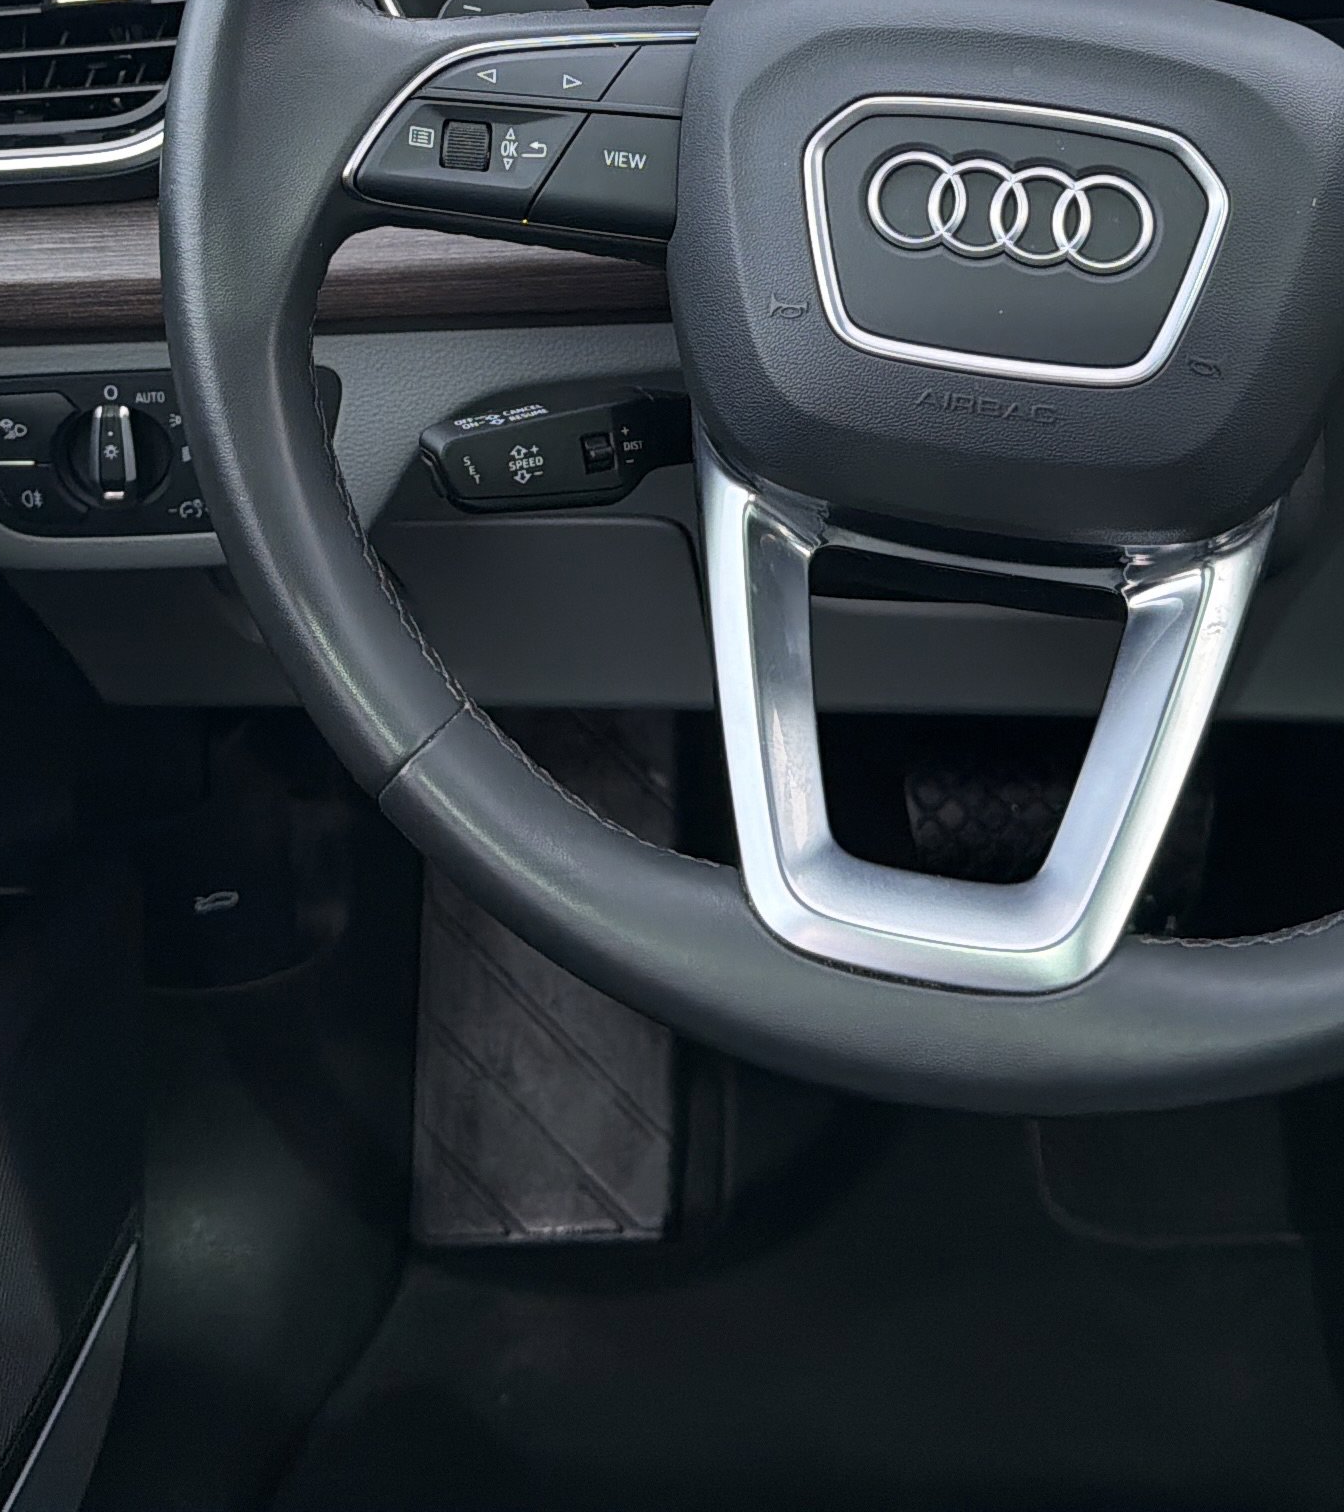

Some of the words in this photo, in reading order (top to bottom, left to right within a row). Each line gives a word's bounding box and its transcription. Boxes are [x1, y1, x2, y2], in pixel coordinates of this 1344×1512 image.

[500, 140, 518, 158] OK
[604, 150, 647, 170] VIEW
[135, 391, 165, 404] AUTO
[915, 389, 1058, 424] AIRBAG
[623, 440, 643, 452] DIST
[508, 456, 544, 472] SPEED
